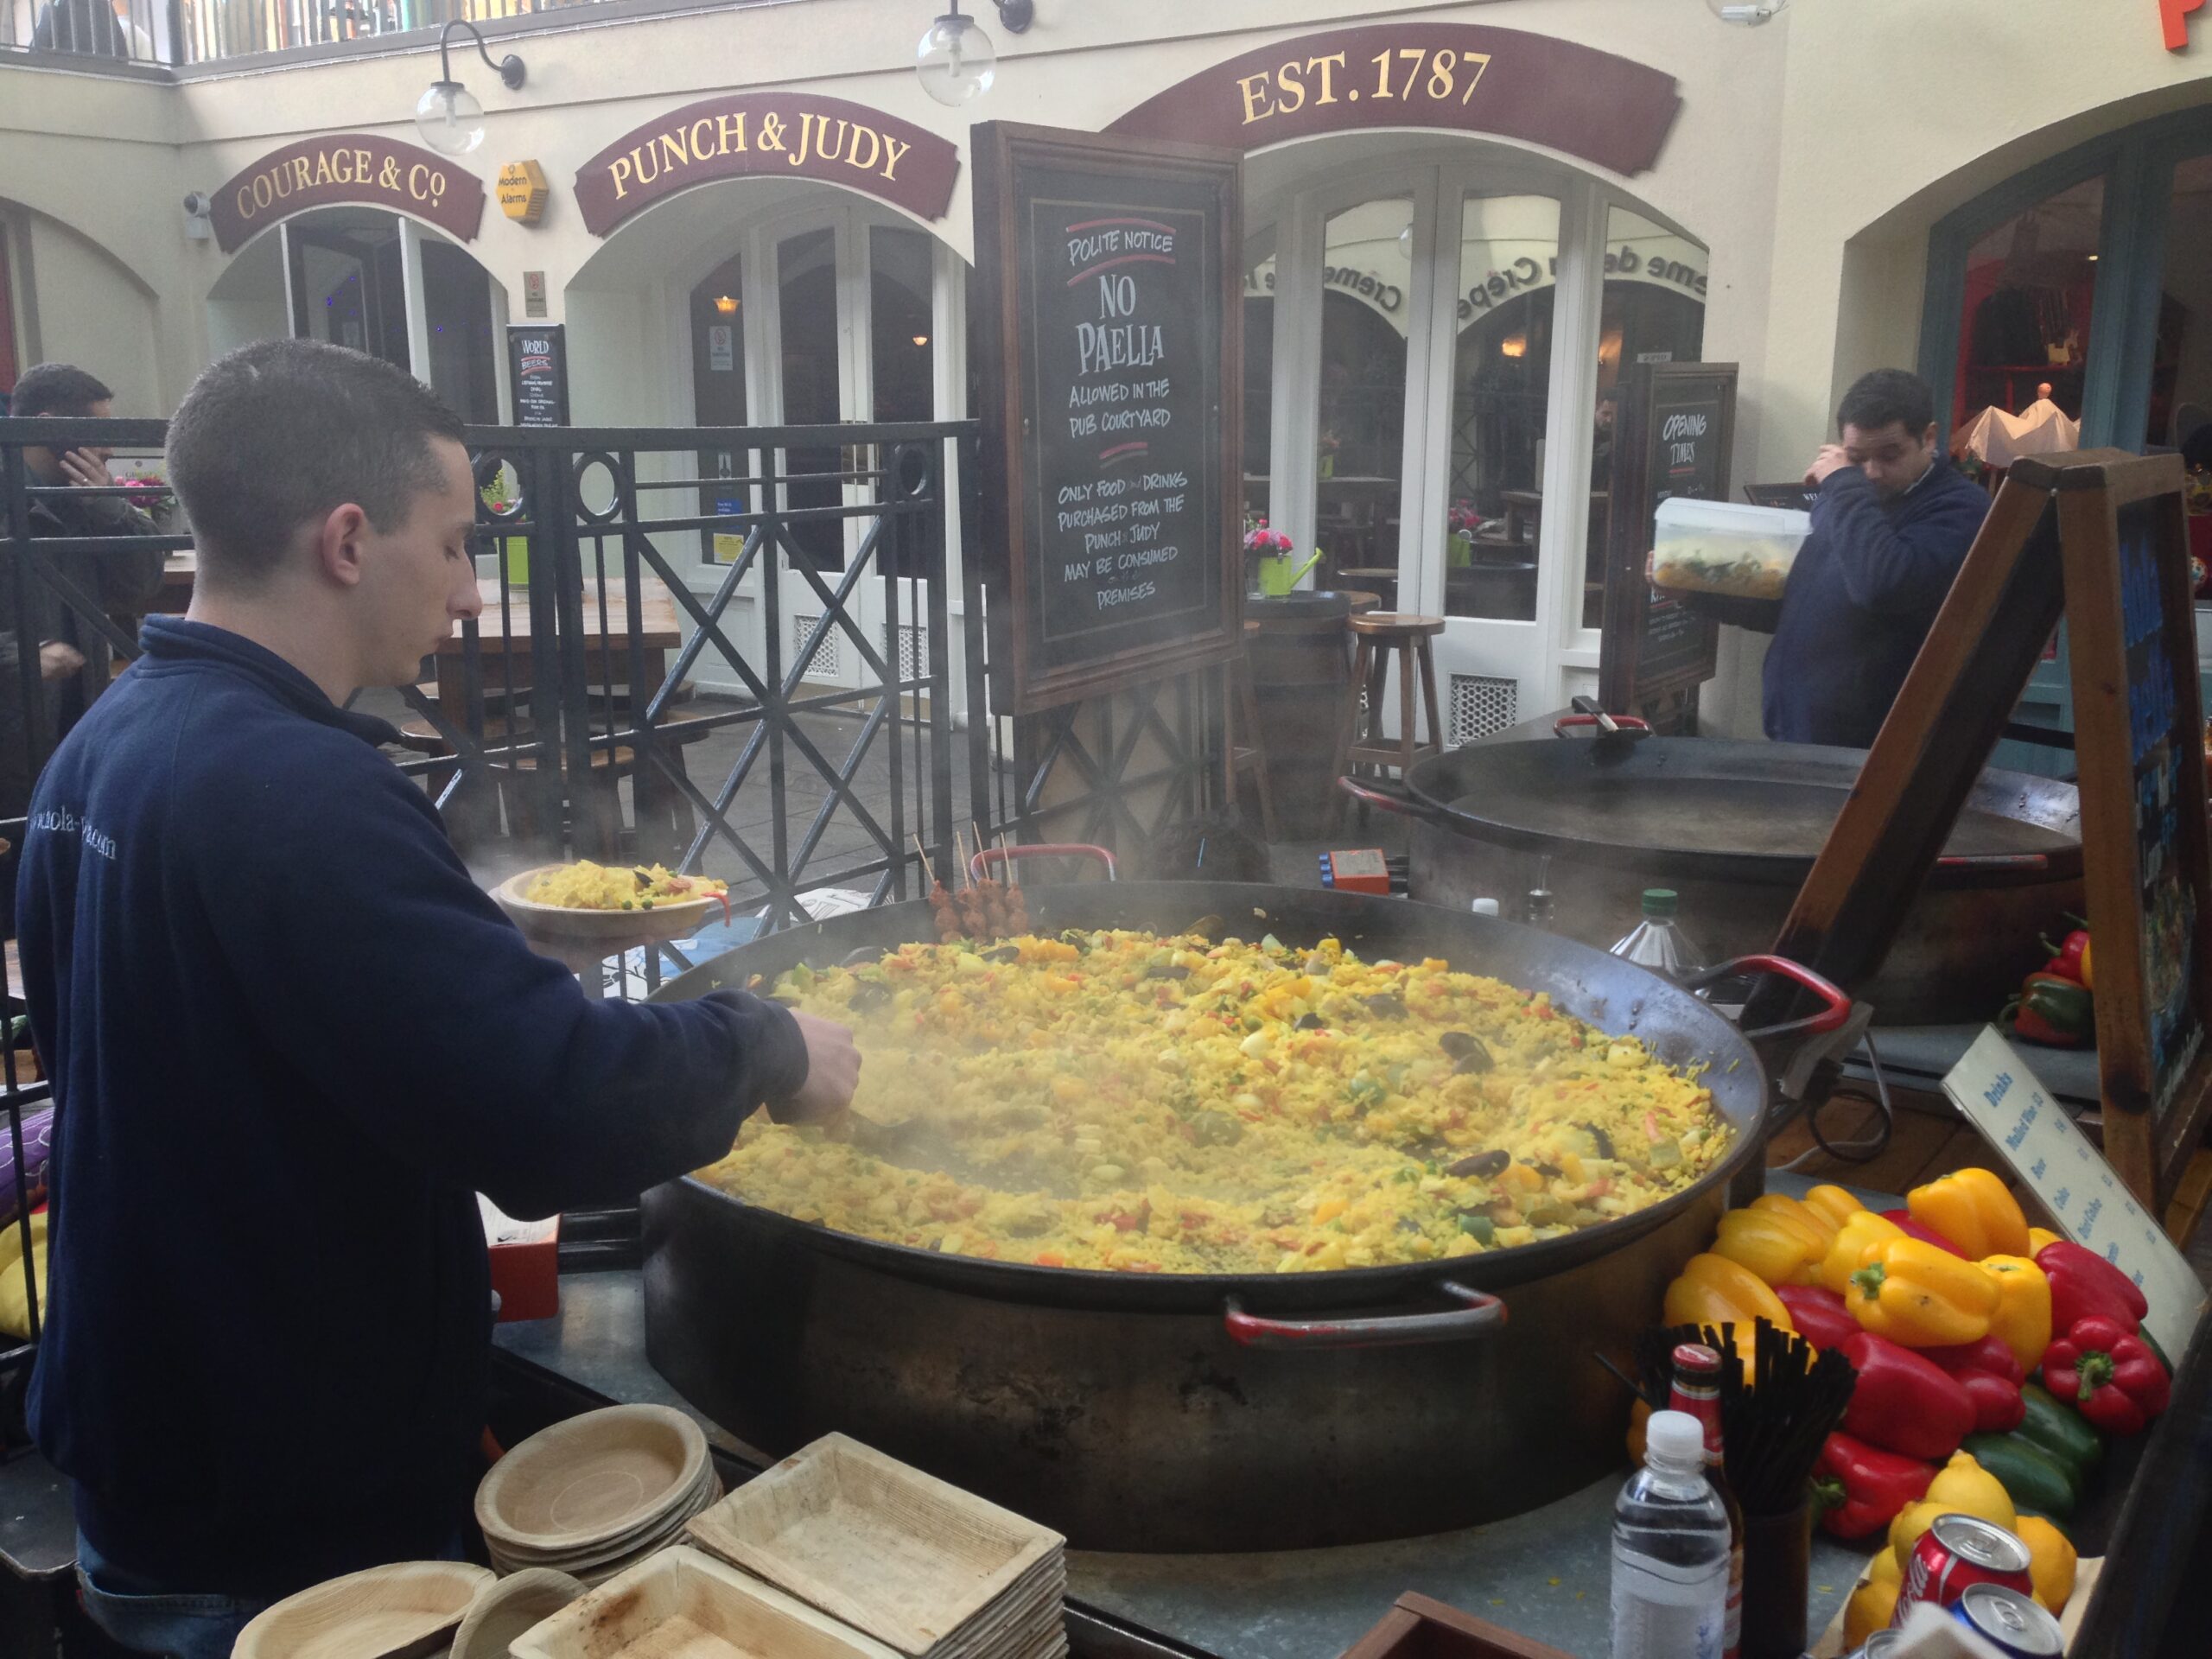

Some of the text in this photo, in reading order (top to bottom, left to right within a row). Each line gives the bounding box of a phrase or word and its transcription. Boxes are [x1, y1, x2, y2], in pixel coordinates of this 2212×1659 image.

[1236, 48, 1491, 124] EST. 1787
[607, 111, 911, 200] PUNCH & JUDY
[237, 149, 373, 219] COURAGE
[378, 156, 401, 192] &
[498, 175, 527, 187] Modern
[500, 193, 526, 204] Alarms
[1067, 229, 1173, 266] POLITE NOTICE
[1099, 274, 1136, 320] NO
[521, 340, 550, 354] WORLD
[1076, 321, 1165, 376] PAELLA
[521, 359, 549, 370] BEERS
[1069, 378, 1170, 409] ALLOWED IN THE
[1069, 408, 1171, 438] PUB COURTYARD
[1662, 414, 1707, 442] OPENING
[1670, 442, 1696, 467] TIMES
[1058, 483, 1093, 505] ONLY
[1096, 479, 1126, 497] FOOD
[1143, 471, 1188, 492] DRINKS
[1058, 493, 1185, 532] PURCHASED FROM THE
[1084, 530, 1122, 554] PUNCH
[1129, 521, 1160, 543] JUDY
[1064, 561, 1091, 582] MAY
[1096, 556, 1113, 575] BE
[1118, 546, 1178, 569] CONSUMED
[1097, 581, 1155, 610] PREMISES
[1983, 1071, 2013, 1108] Drinks
